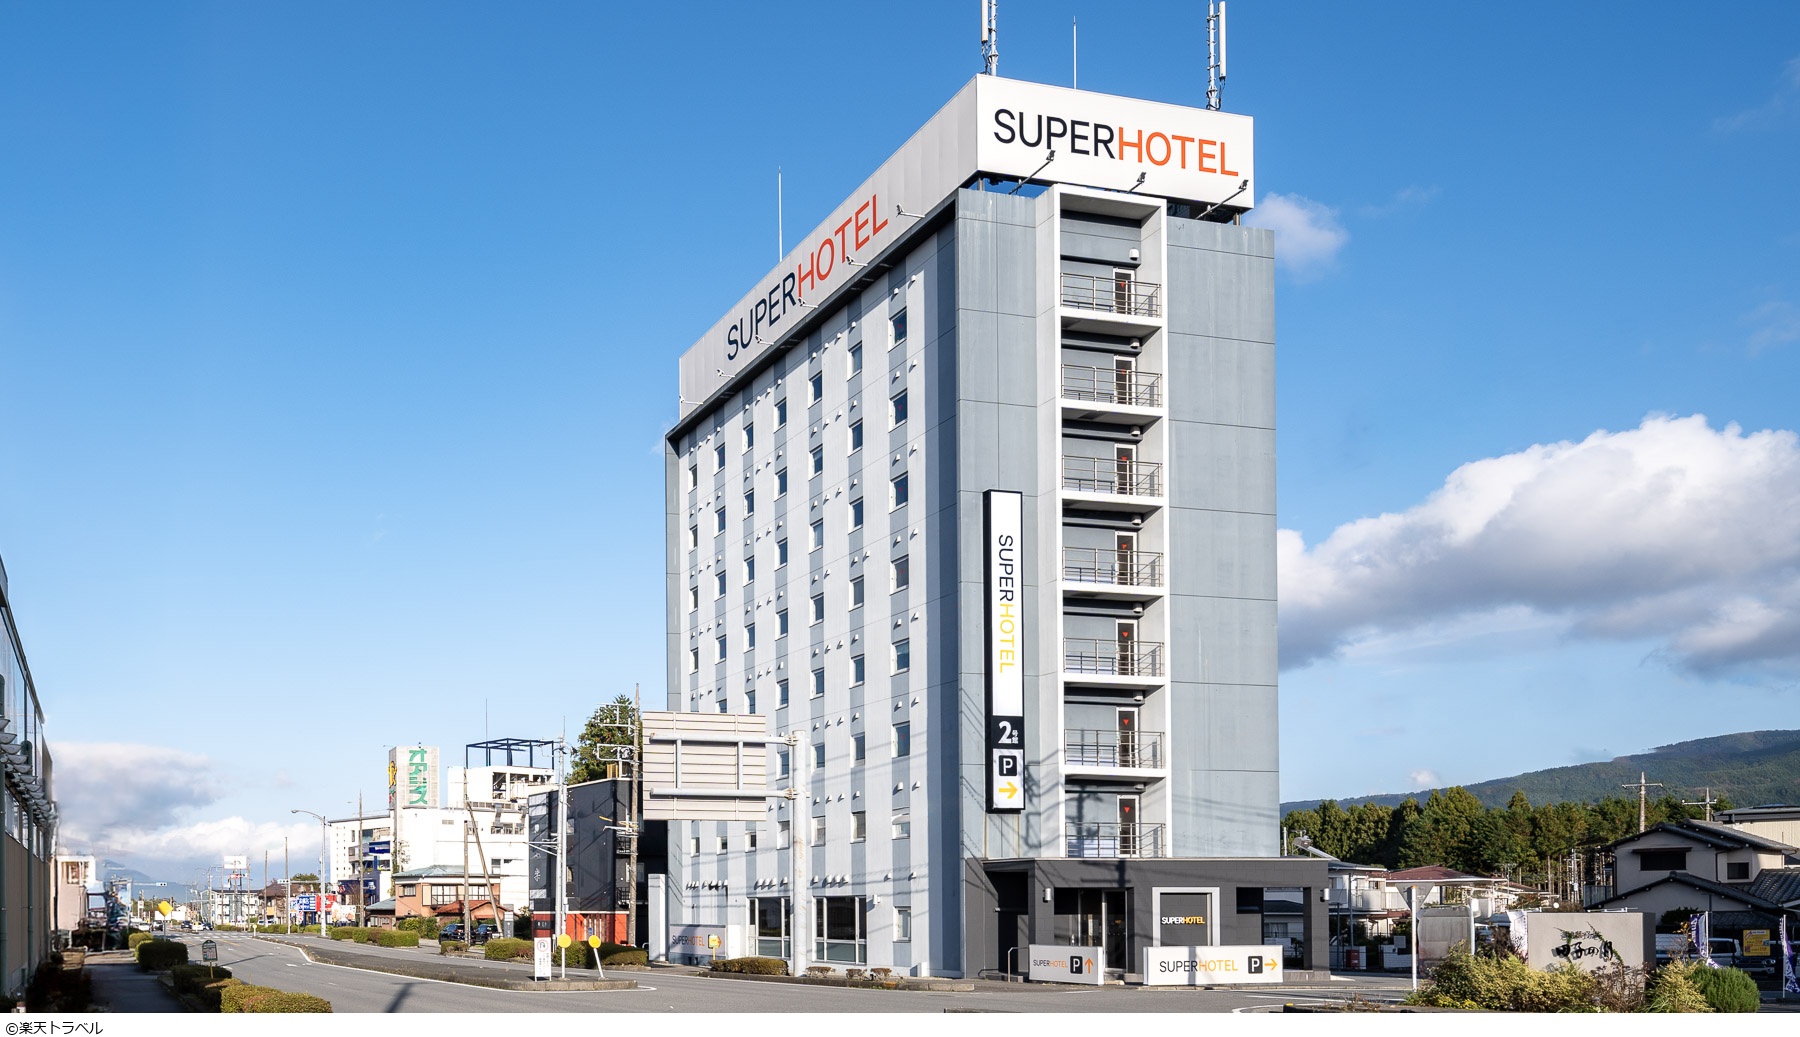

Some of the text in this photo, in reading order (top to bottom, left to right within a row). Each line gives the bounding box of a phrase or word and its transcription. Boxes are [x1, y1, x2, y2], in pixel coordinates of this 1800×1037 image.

[993, 108, 1239, 177] SUPERHOTEL
[726, 193, 888, 361] SUPERHOTEL
[998, 534, 1014, 673] SUPERHOTEL
[1032, 958, 1068, 968] SUPERHOTEL
[1159, 959, 1238, 973] SUPERHOTEL
